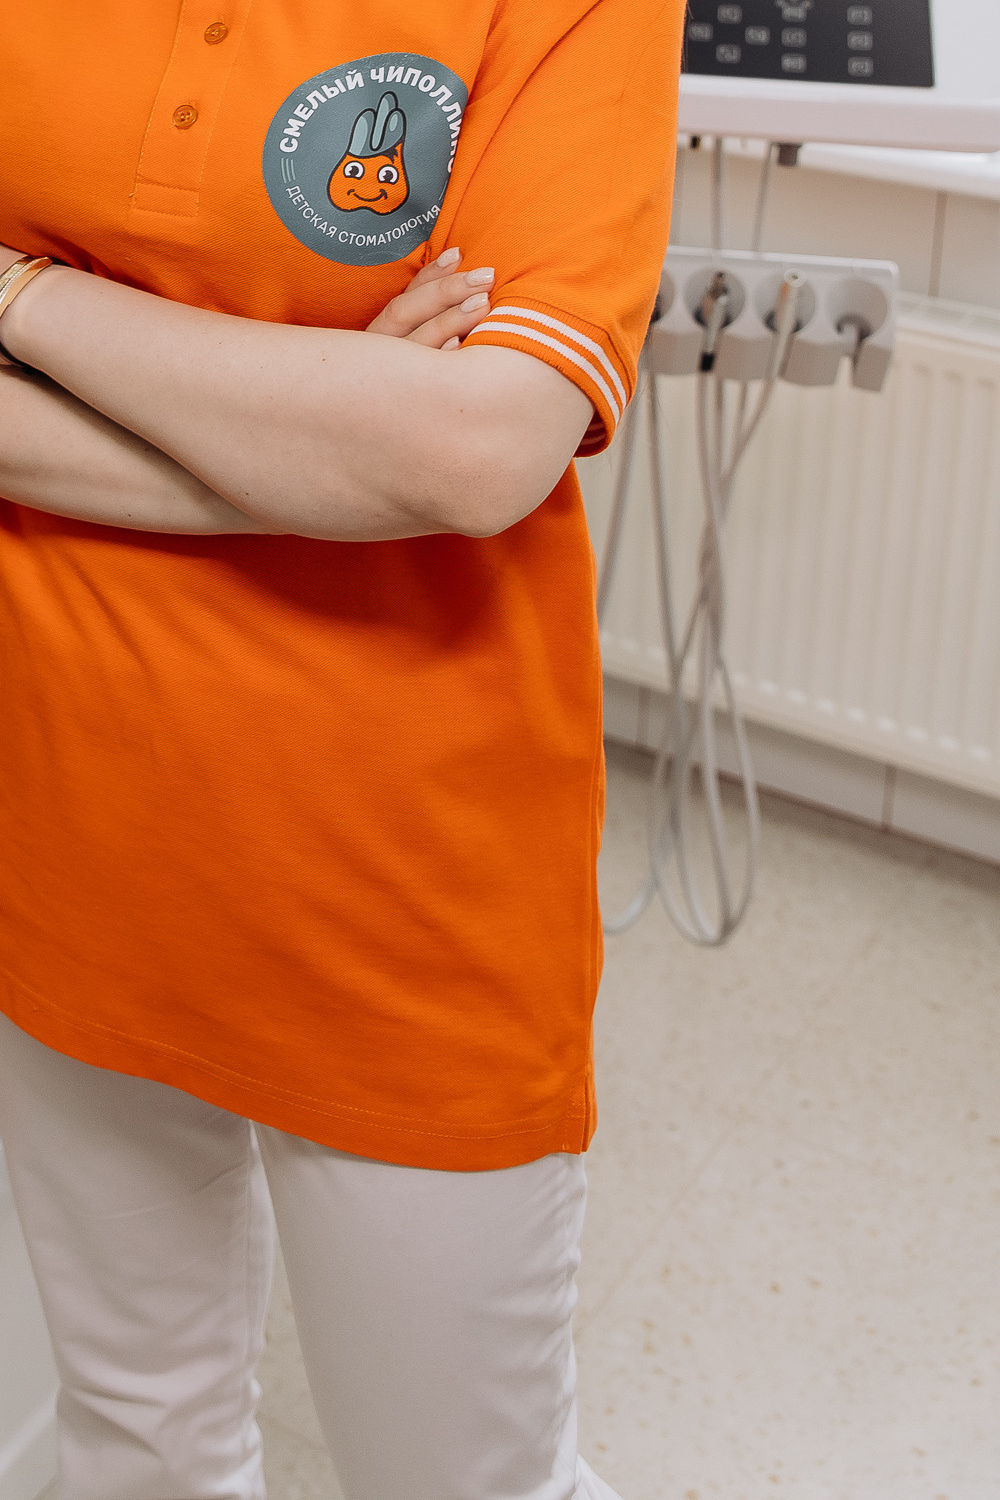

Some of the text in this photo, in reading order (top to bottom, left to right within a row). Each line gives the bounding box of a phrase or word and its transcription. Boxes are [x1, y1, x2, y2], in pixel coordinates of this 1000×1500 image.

[279, 69, 365, 153] СМЕЛЫЙ
[286, 185, 441, 247] ДЕТСКАЯ СТОМАТОЛОГИЯ
